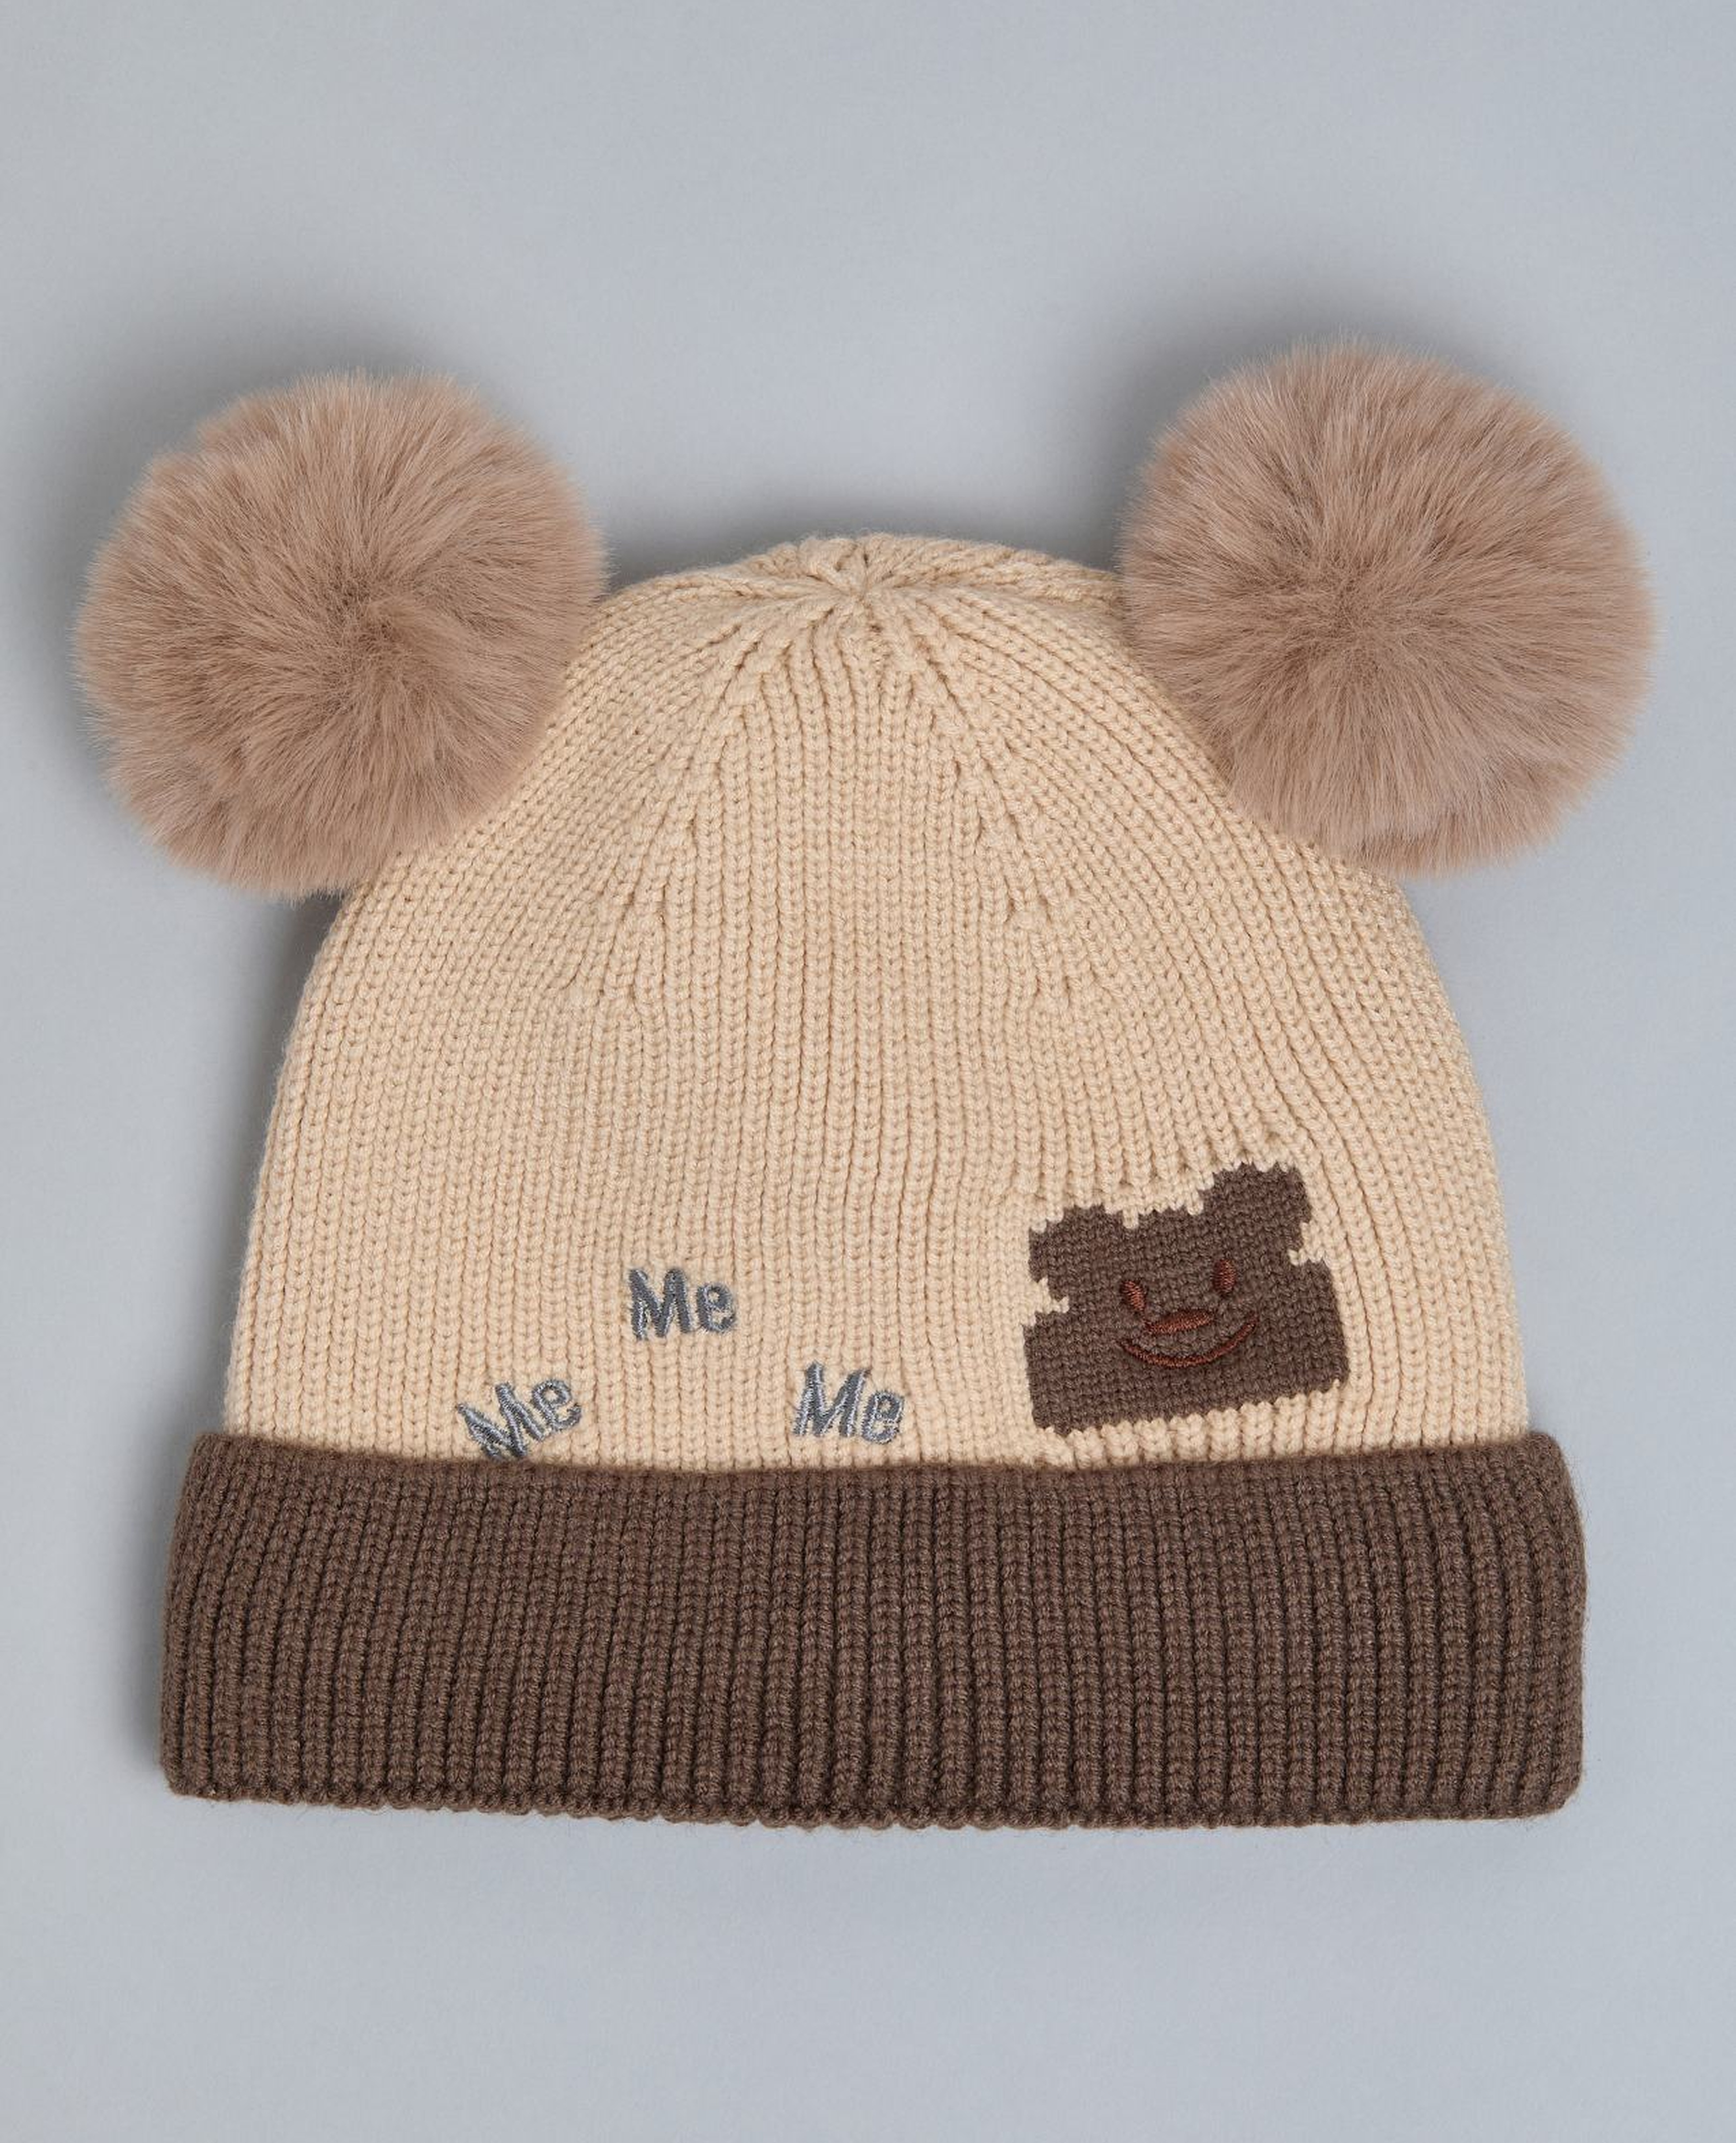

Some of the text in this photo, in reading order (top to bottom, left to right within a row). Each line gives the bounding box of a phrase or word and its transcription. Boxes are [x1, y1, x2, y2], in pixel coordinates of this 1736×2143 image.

[628, 1268, 736, 1341] Me
[458, 1378, 582, 1460] Me
[793, 1360, 904, 1444] Me
